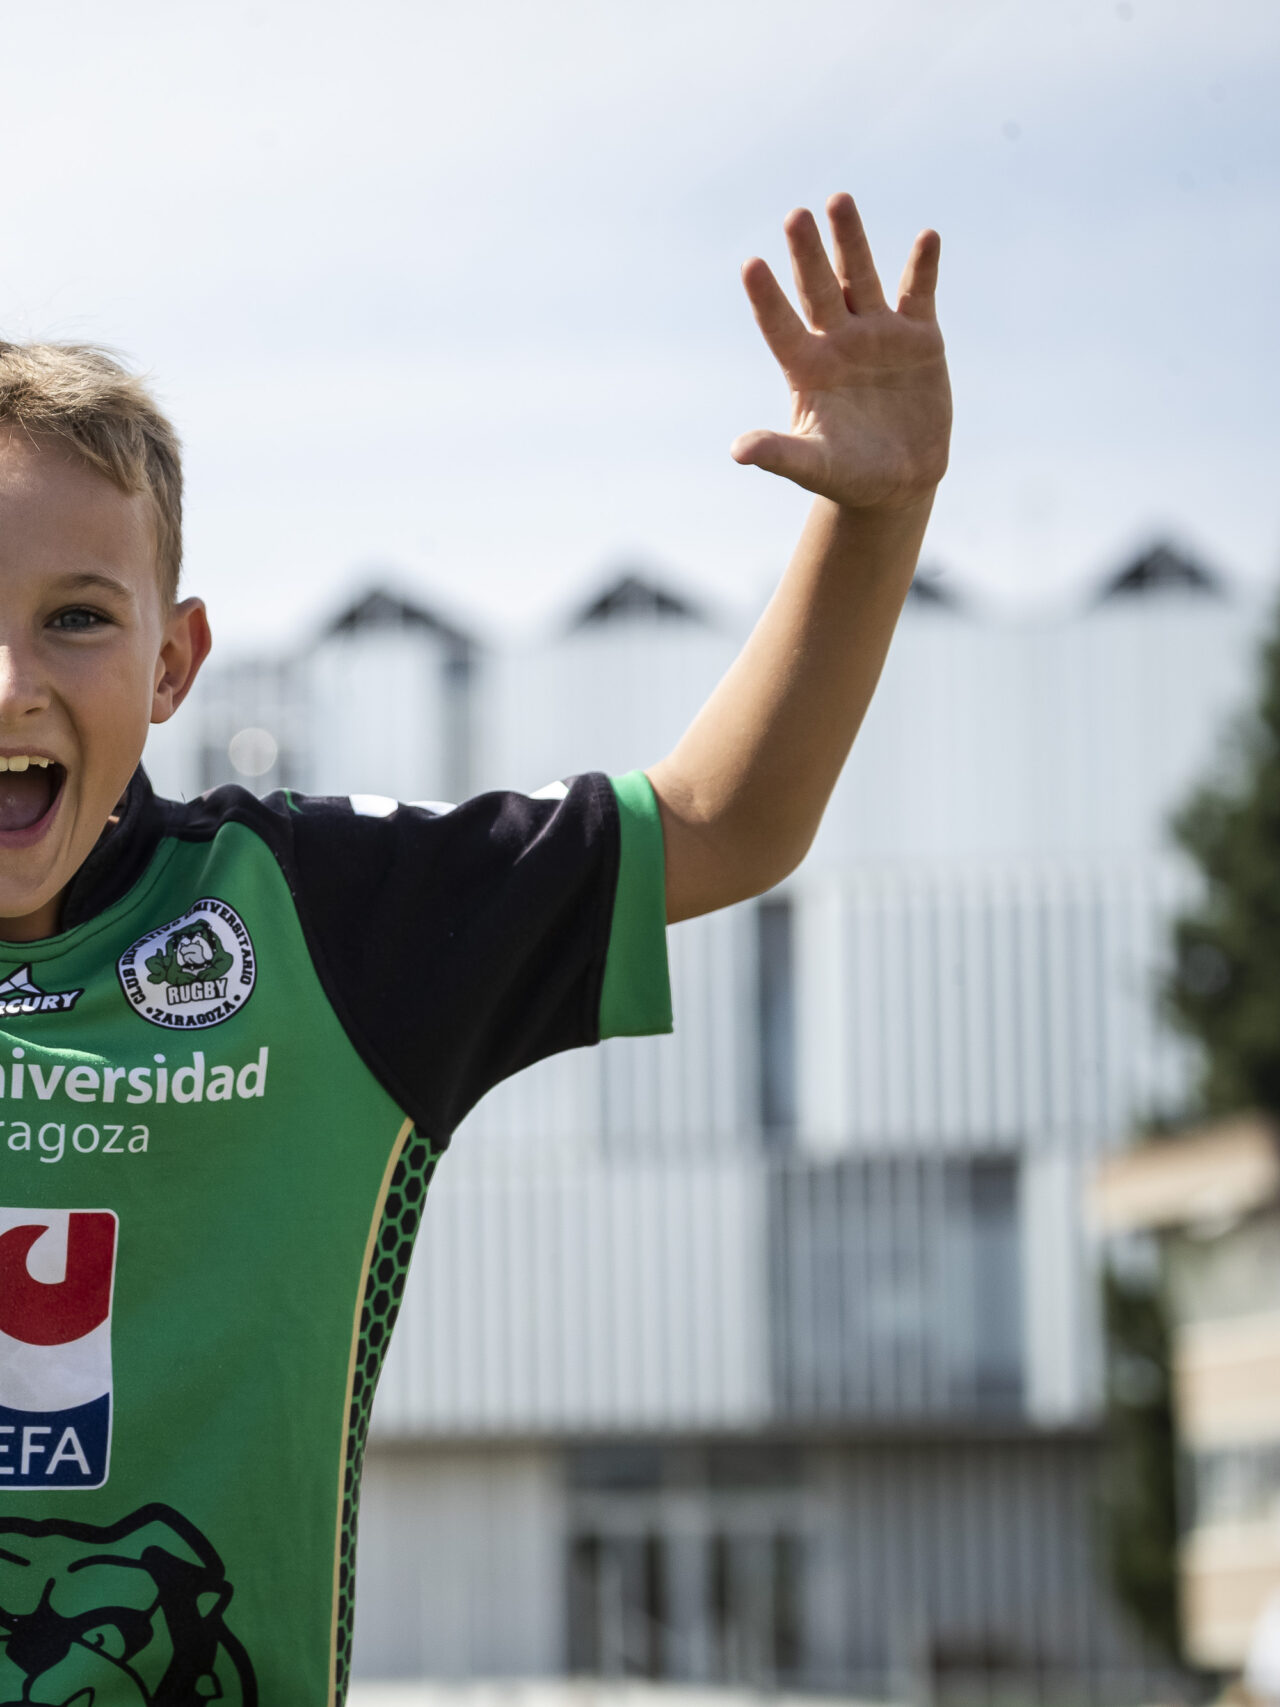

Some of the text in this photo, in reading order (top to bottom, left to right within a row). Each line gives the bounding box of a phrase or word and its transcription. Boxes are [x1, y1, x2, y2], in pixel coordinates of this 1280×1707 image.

[122, 967, 146, 1005] CLUB
[166, 977, 228, 1006] RUGBY
[151, 1000, 236, 1027] ZARAGOZA
